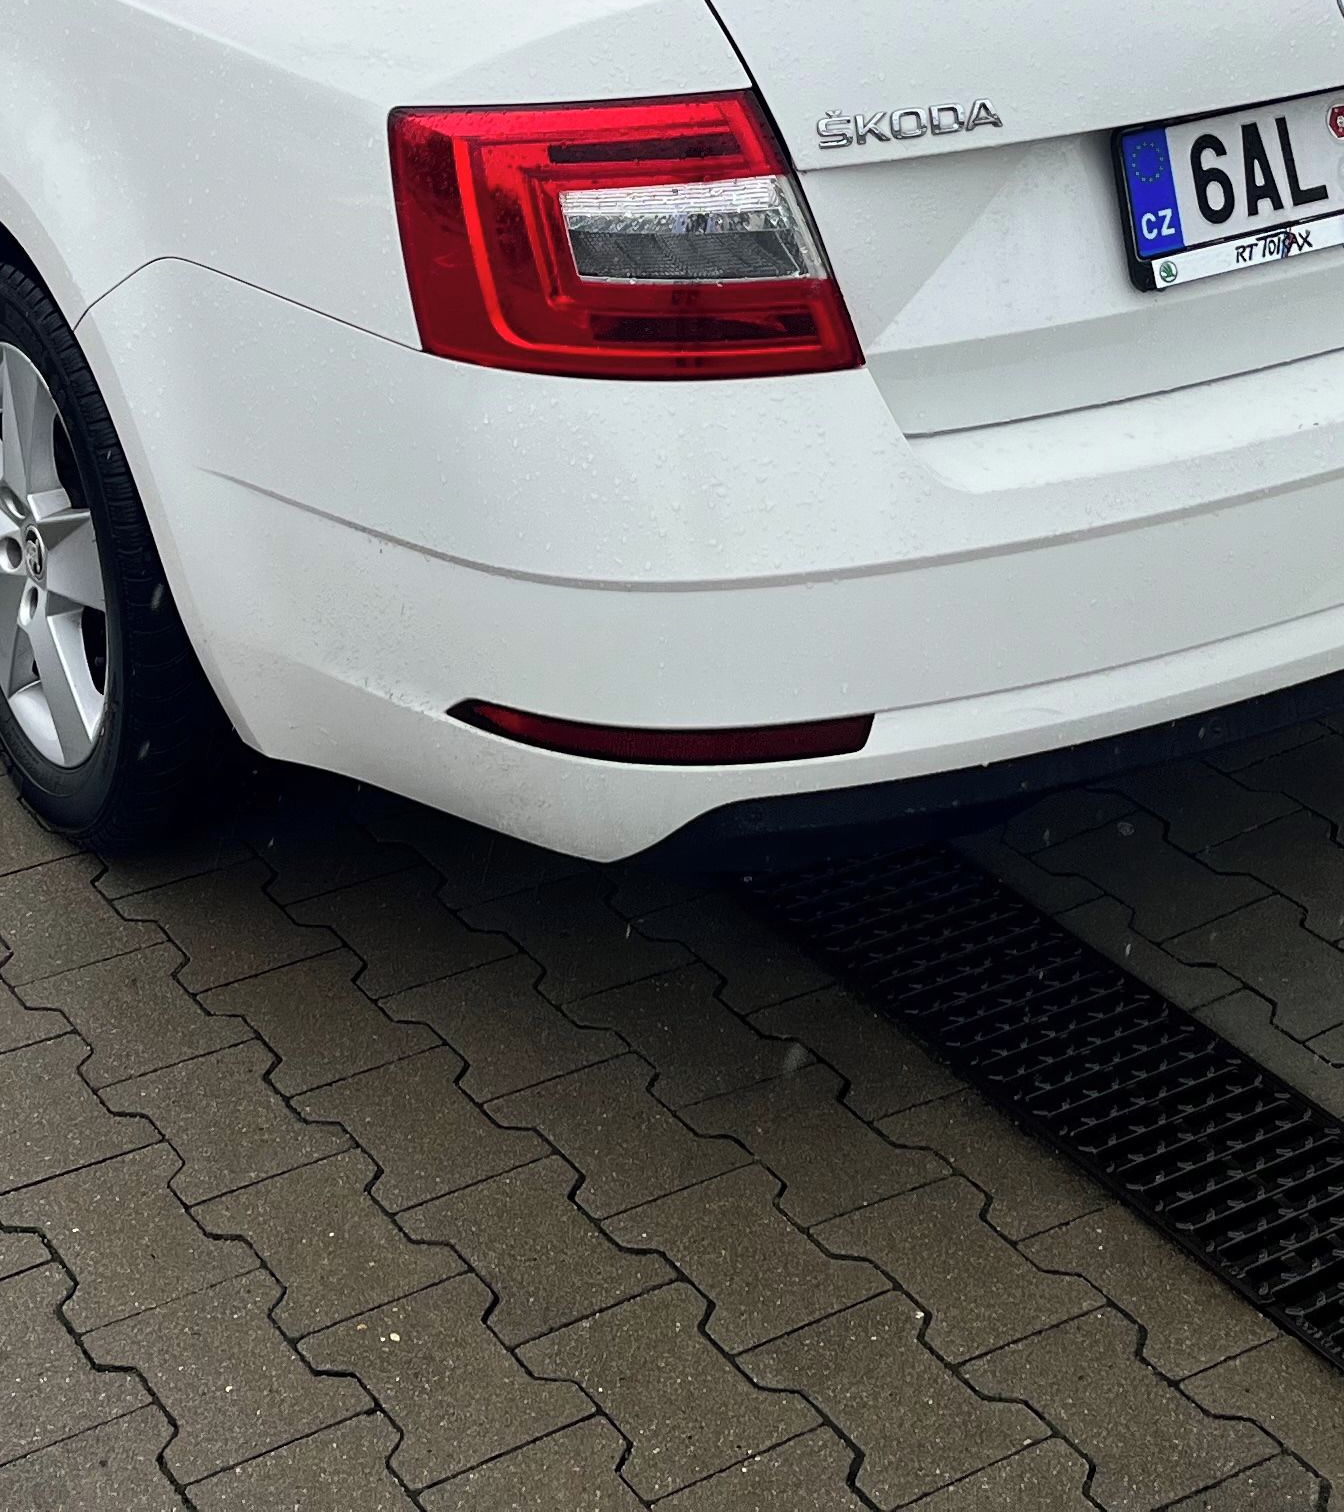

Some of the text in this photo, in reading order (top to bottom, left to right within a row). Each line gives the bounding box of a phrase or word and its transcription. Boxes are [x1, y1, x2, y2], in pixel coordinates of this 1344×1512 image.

[816, 97, 1003, 149] ŠKODA
[1190, 117, 1329, 225] 6AL
[1141, 208, 1176, 240] CZ
[1235, 243, 1258, 263] RT
